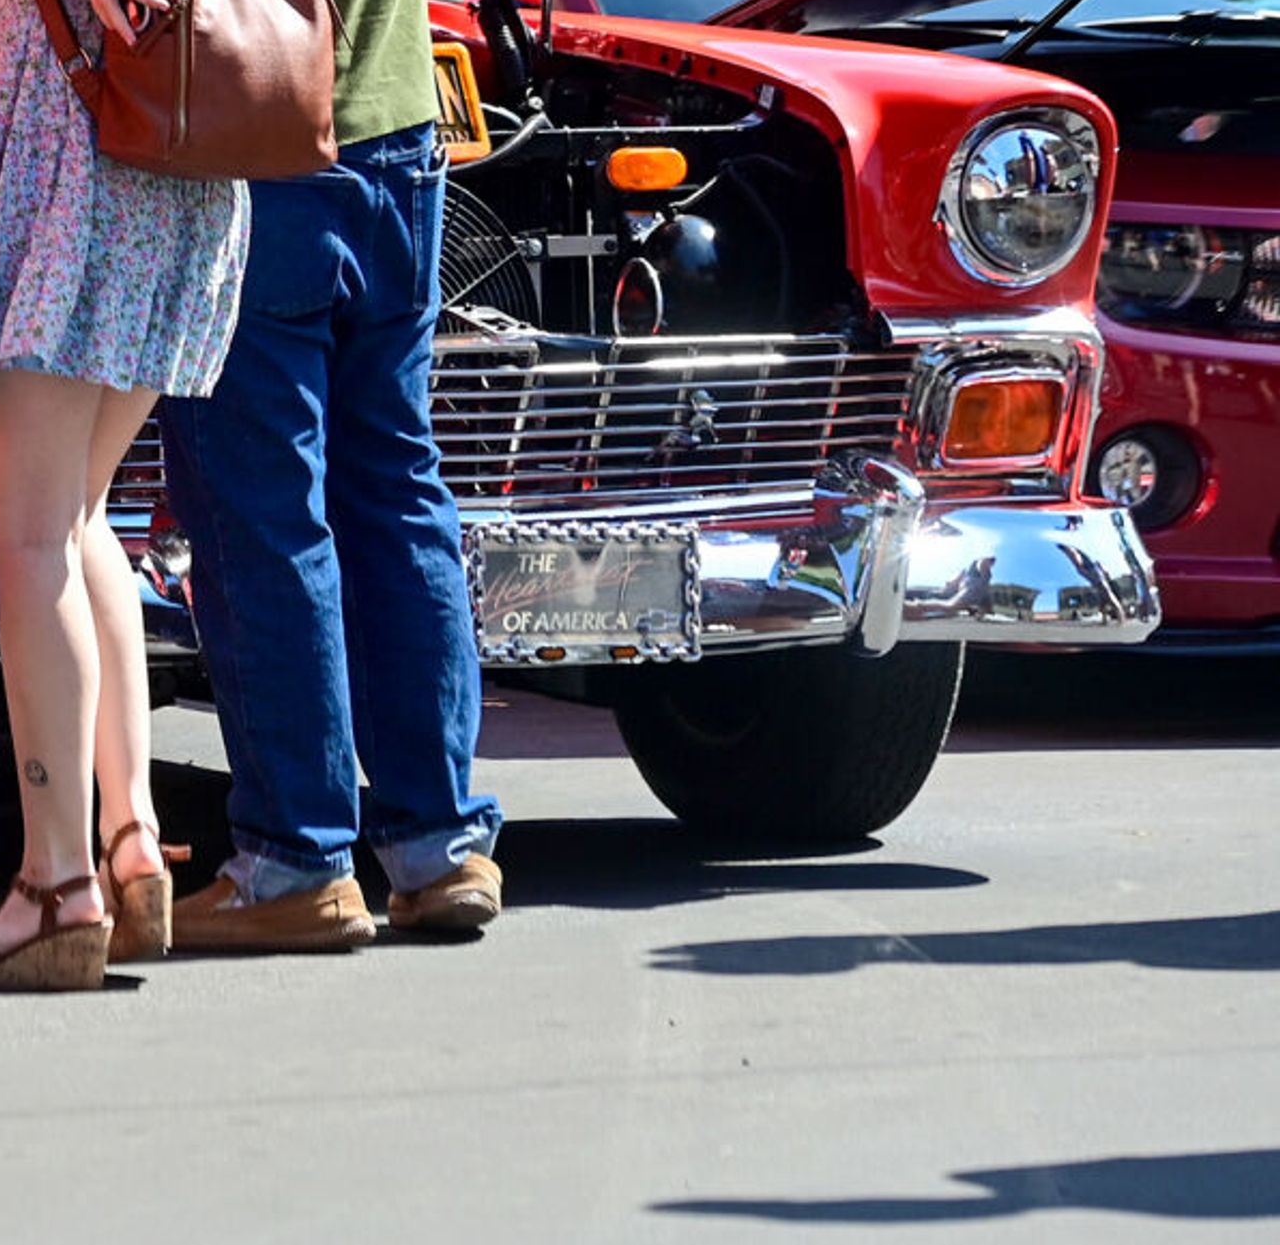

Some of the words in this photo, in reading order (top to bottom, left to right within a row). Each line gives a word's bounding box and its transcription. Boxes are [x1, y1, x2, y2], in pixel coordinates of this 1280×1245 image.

[517, 553, 557, 574] THE
[502, 611, 533, 633] OF
[534, 611, 630, 632] AMERICA
